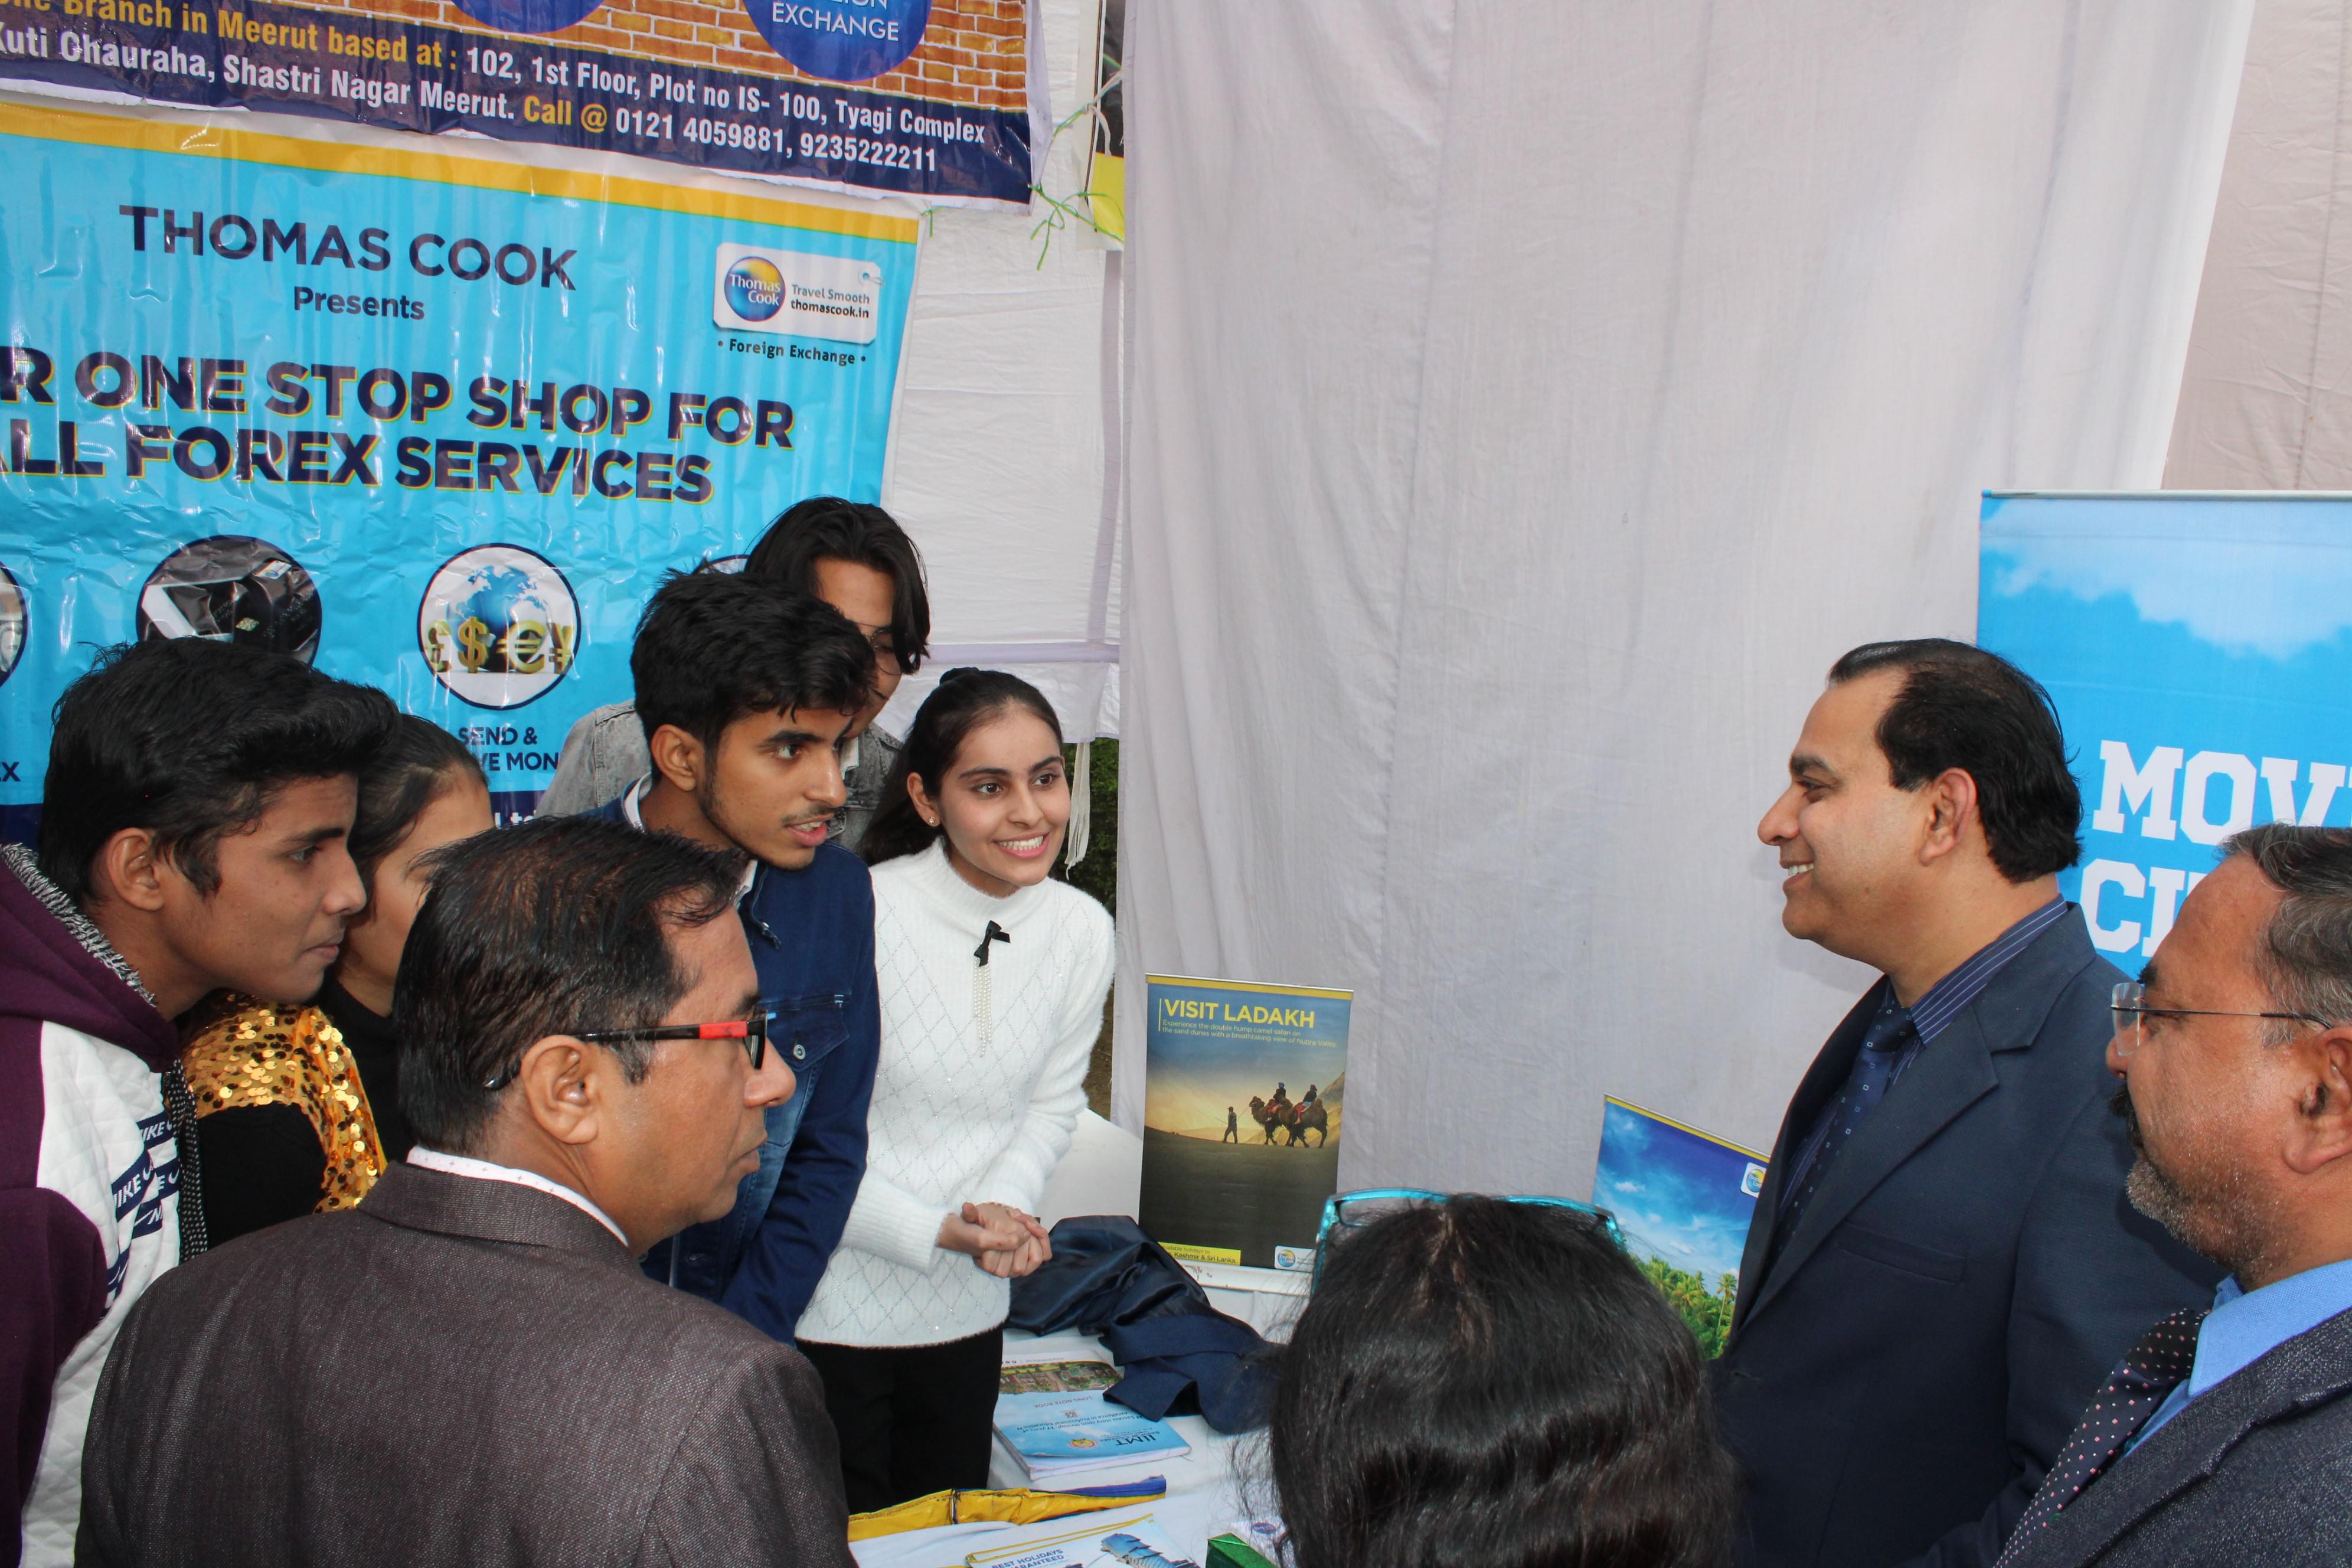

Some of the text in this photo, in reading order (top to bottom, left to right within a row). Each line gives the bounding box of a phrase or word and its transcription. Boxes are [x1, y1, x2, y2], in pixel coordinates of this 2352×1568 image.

[772, 2, 899, 41] EXCHANGE
[64, 0, 171, 28] Branch
[182, 3, 207, 34] in
[218, 10, 318, 51] Meerut
[329, 27, 407, 63] based
[417, 44, 442, 69] at
[466, 47, 521, 84] 102,
[532, 57, 569, 86] 1st
[577, 63, 641, 101] Floor,
[650, 74, 695, 104] Plot
[704, 90, 730, 109] no
[739, 84, 770, 112] IS-
[779, 93, 827, 125] 100,
[836, 99, 893, 133] Tyagi
[900, 110, 985, 145] Complex
[60, 30, 215, 83] Chauraha,
[224, 55, 321, 96] Shastri
[332, 70, 410, 109] Nagar
[421, 81, 514, 119] Meerut.
[524, 96, 571, 125] Call
[580, 103, 607, 133] @
[616, 109, 673, 140] 0121
[684, 118, 793, 159] 4059881,
[801, 137, 935, 172] 9235222211
[119, 205, 577, 290] THOMAS COOK
[730, 274, 781, 293] Thomas
[792, 284, 870, 304] Travel Smooth
[294, 286, 424, 321] Presents
[748, 290, 779, 306] Cook
[791, 299, 869, 318] thomascook.in
[729, 338, 855, 366] Foreign Exchange
[75, 351, 247, 413] ONE
[264, 361, 452, 422] STOP
[466, 376, 651, 437] SHOP
[667, 392, 794, 451] FOR
[0, 419, 714, 505] LL FOREX SERVICES
[459, 727, 538, 745] SEND &
[2092, 739, 2352, 845] MOV
[2080, 858, 2207, 958] CI
[1164, 999, 1315, 1028] VISIT LADAKH
[1231, 1033, 1270, 1043] breathtaking
[1115, 1435, 1157, 1446] IIMT
[1010, 1554, 1064, 1568] ARANTEED
[1017, 1549, 1063, 1564] HOLIDAYS
